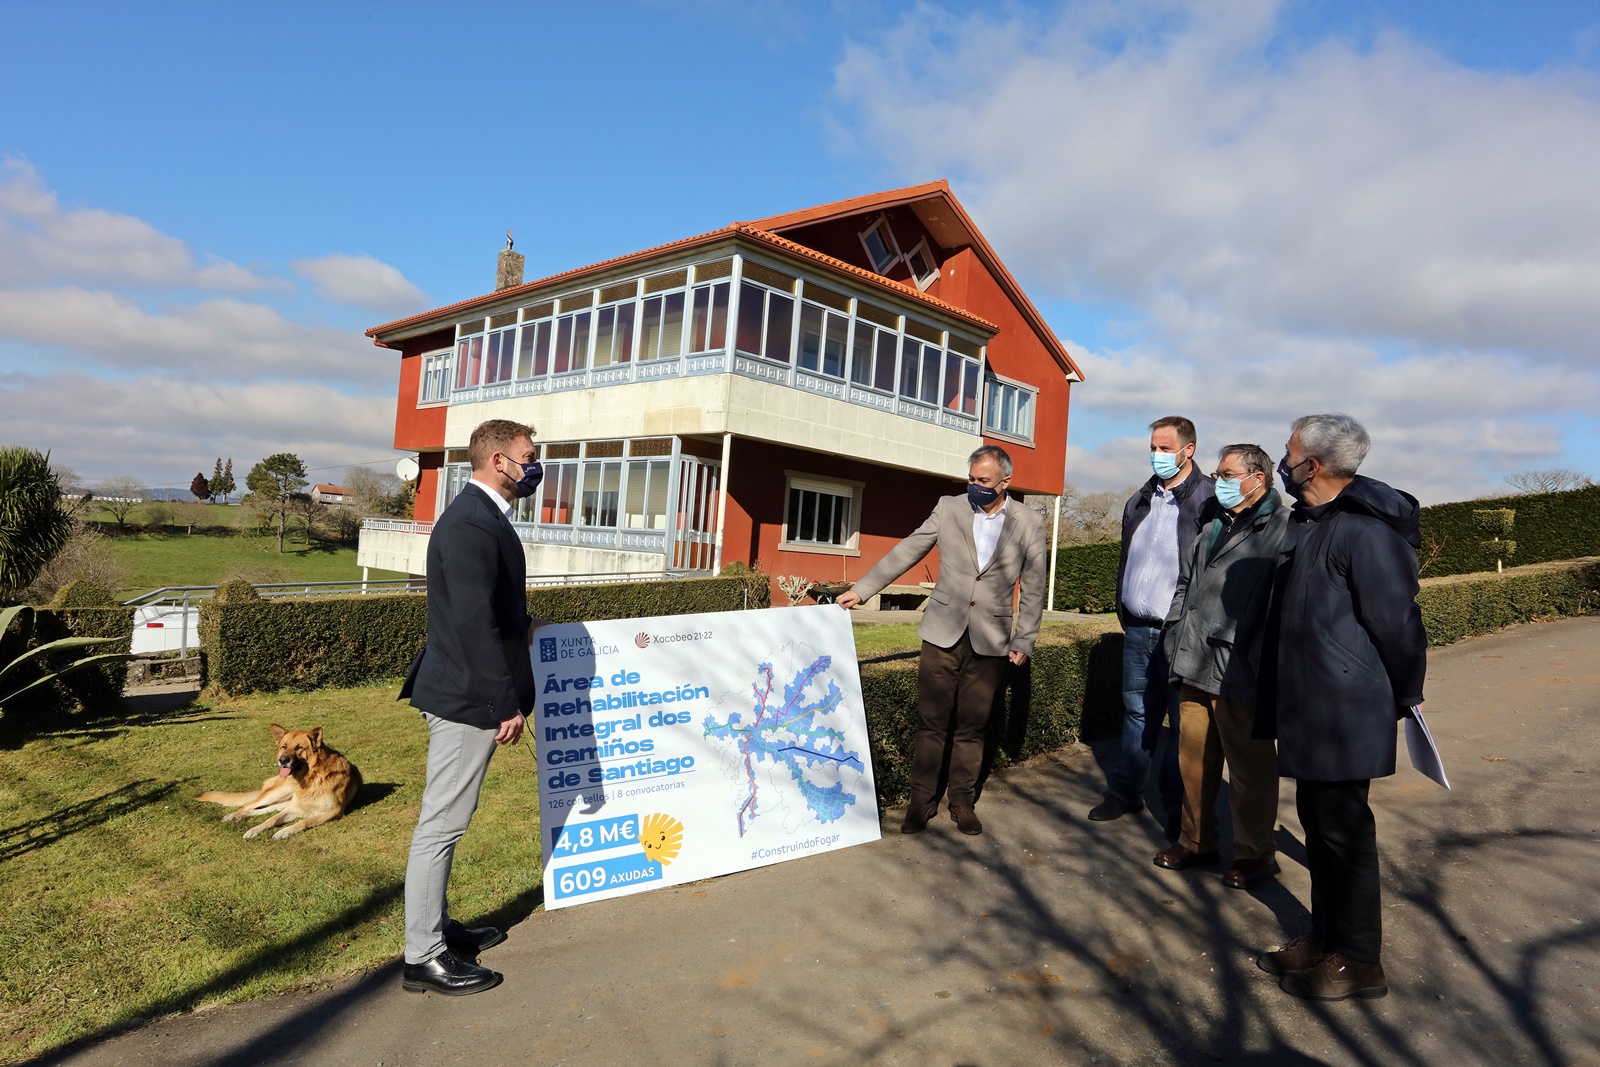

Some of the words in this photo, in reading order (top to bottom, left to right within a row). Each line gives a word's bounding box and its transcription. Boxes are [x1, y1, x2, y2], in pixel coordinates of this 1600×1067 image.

[561, 636, 597, 648] XUNTA
[561, 649, 575, 659] DE
[577, 645, 620, 657] GALICIA
[653, 633, 693, 645] Xacobeo
[543, 673, 604, 694] Área
[611, 669, 641, 686] de
[543, 683, 709, 718] Rehabilitación
[545, 714, 642, 741] Integral
[648, 711, 692, 728] dos
[546, 738, 655, 765] Camiños
[548, 771, 581, 789] de
[588, 755, 695, 782] Santiago
[548, 798, 565, 809] 126
[566, 793, 610, 807] concellos
[617, 789, 624, 799] 8
[625, 780, 686, 798] convocatorias
[555, 827, 594, 853] 4,8
[600, 820, 636, 845] M€
[559, 866, 607, 894] 609
[610, 866, 655, 885] AXUDAS
